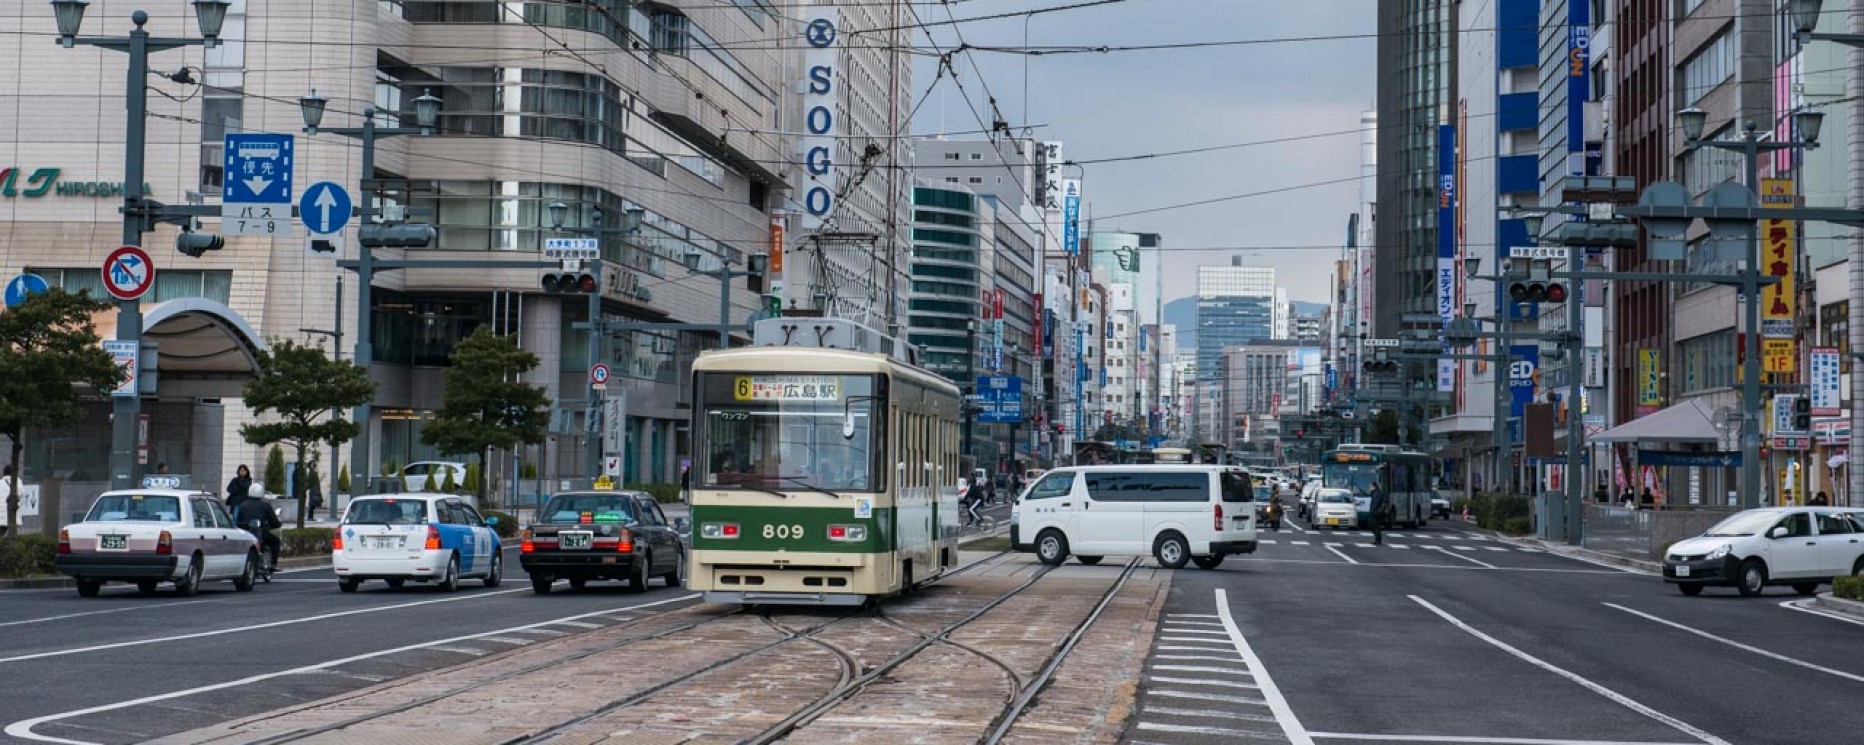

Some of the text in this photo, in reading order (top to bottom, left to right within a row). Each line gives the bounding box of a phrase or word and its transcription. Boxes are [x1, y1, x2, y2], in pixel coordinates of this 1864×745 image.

[806, 65, 832, 216] SOGO
[242, 161, 275, 175] 優先
[241, 207, 272, 218] バス
[1770, 356, 1788, 371] 1F
[739, 379, 748, 396] 6
[783, 384, 837, 398] 広島駅
[721, 412, 749, 420] ワンマン
[762, 524, 804, 539] 809
